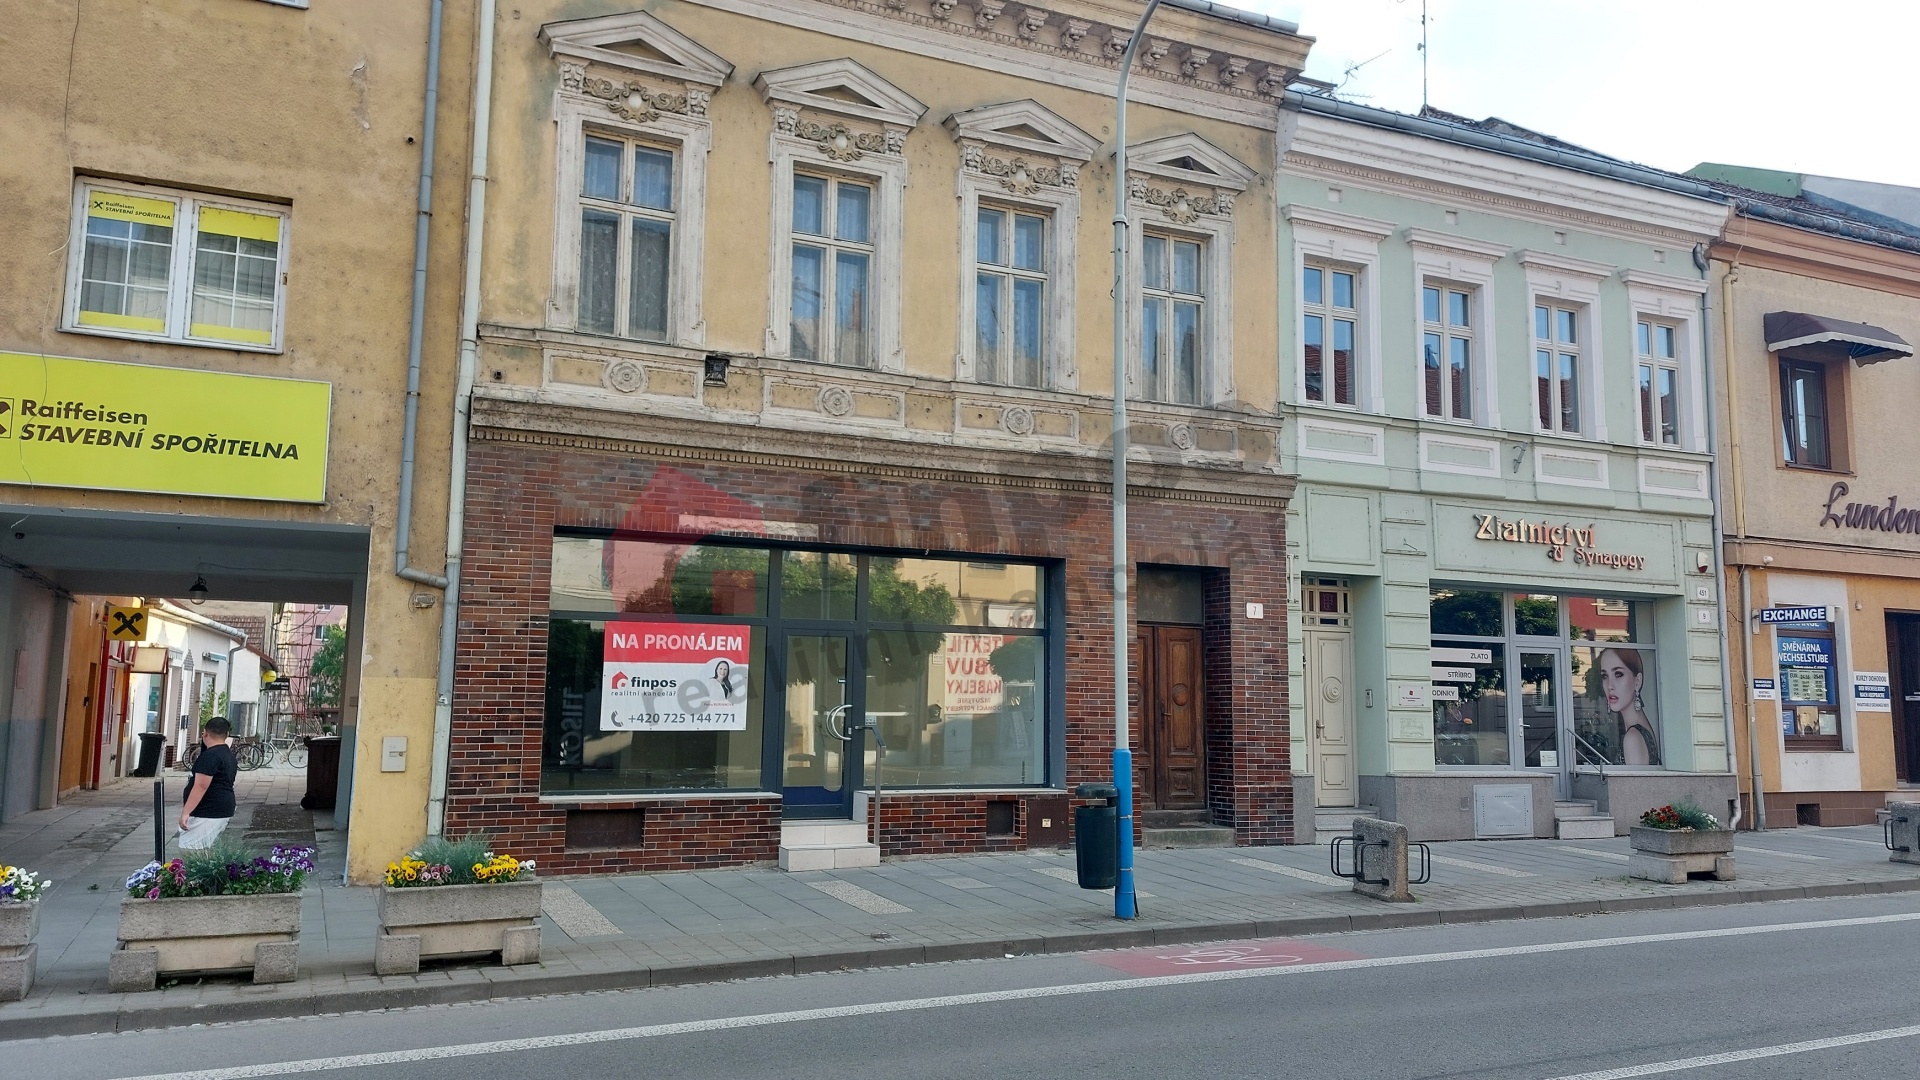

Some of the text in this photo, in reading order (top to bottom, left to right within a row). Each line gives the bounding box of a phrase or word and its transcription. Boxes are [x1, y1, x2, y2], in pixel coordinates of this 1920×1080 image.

[105, 201, 135, 210] Raiffeisen
[105, 206, 171, 220] STAVEBNÍ SPOŘITELNA
[21, 399, 148, 426] Raiffeisen
[19, 423, 299, 460] STAVEBNÍ SPOŘITELNA
[1574, 547, 1646, 570] Synagogy
[1699, 589, 1707, 597] 451
[1763, 608, 1826, 621] EXCHANGE
[612, 632, 743, 651] NA PRONÁJEM
[1782, 641, 1822, 653] SMĚNÁRNA
[631, 676, 677, 690] finpos
[628, 713, 735, 723] +420 725 144 771
